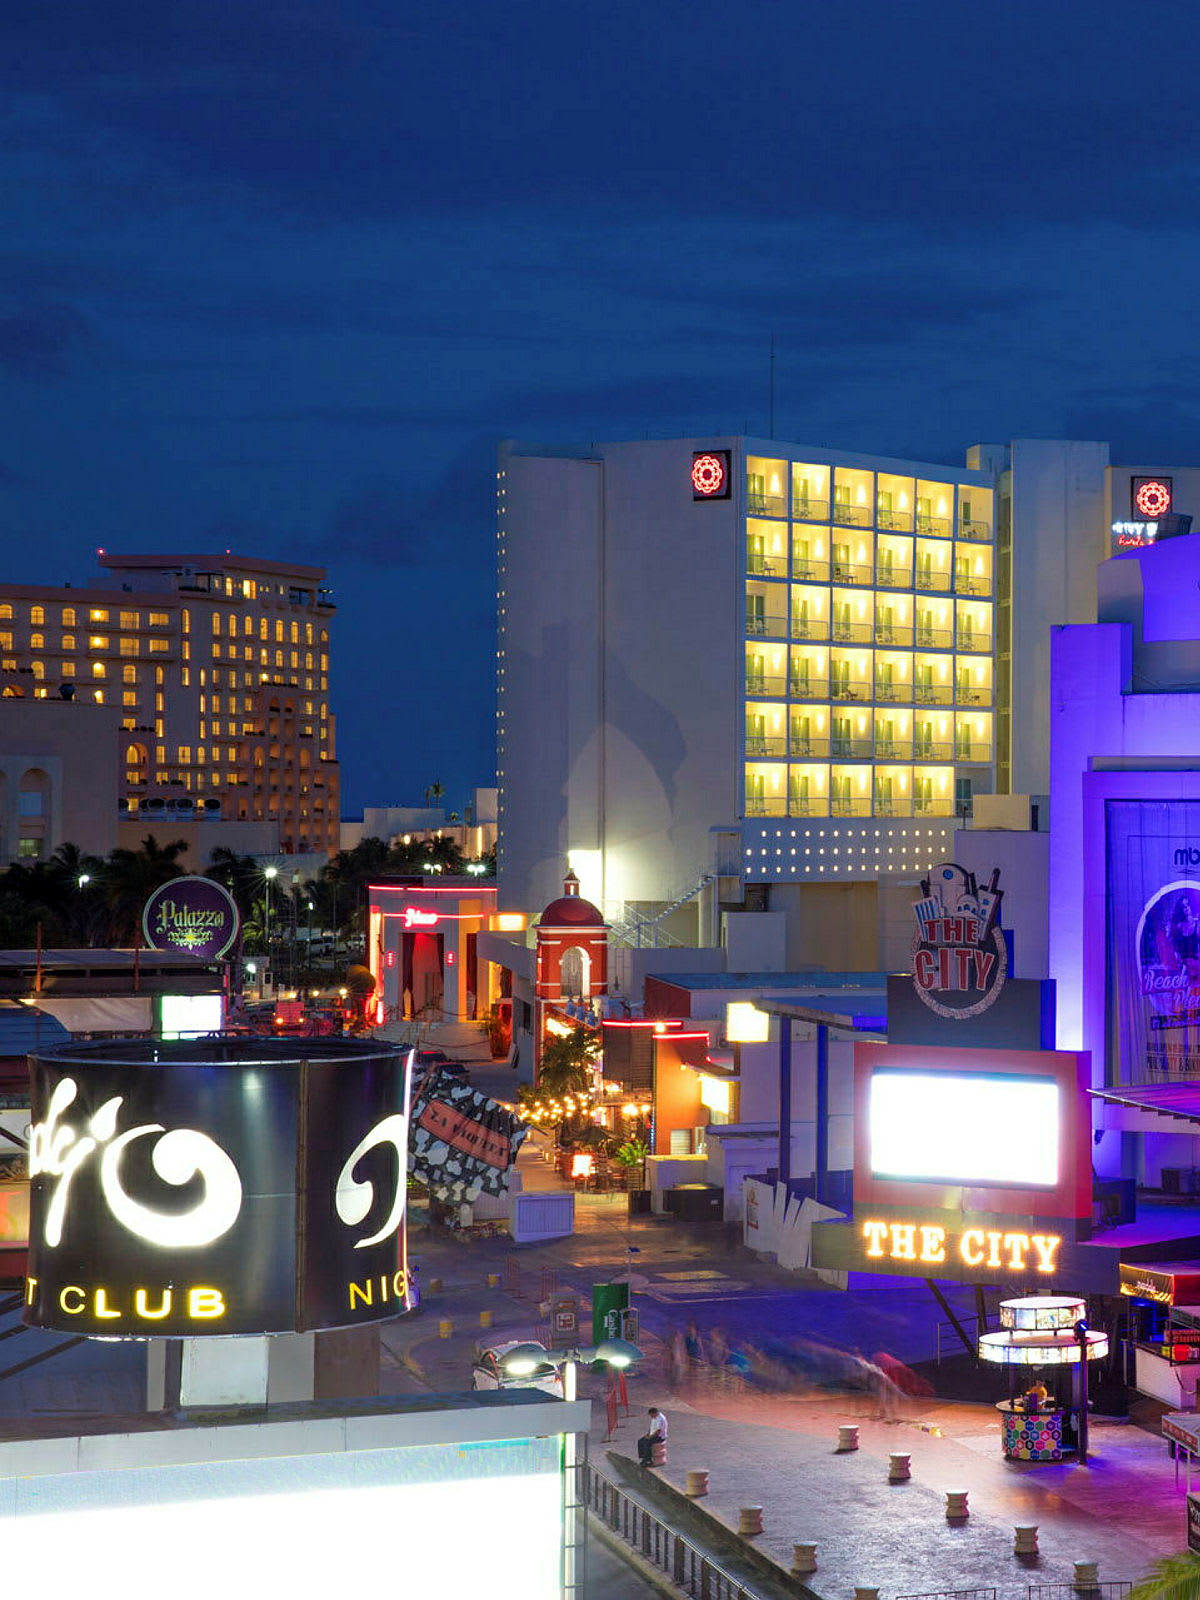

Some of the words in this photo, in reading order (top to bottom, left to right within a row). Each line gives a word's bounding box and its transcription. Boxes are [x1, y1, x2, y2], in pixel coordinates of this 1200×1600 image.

[156, 900, 225, 934] Palazzo
[923, 916, 980, 946] THE
[914, 946, 996, 992] CITY
[1144, 965, 1189, 991] Beach
[863, 1221, 946, 1262] THE
[959, 1229, 1061, 1273] CITY
[59, 1286, 226, 1319] CLUB
